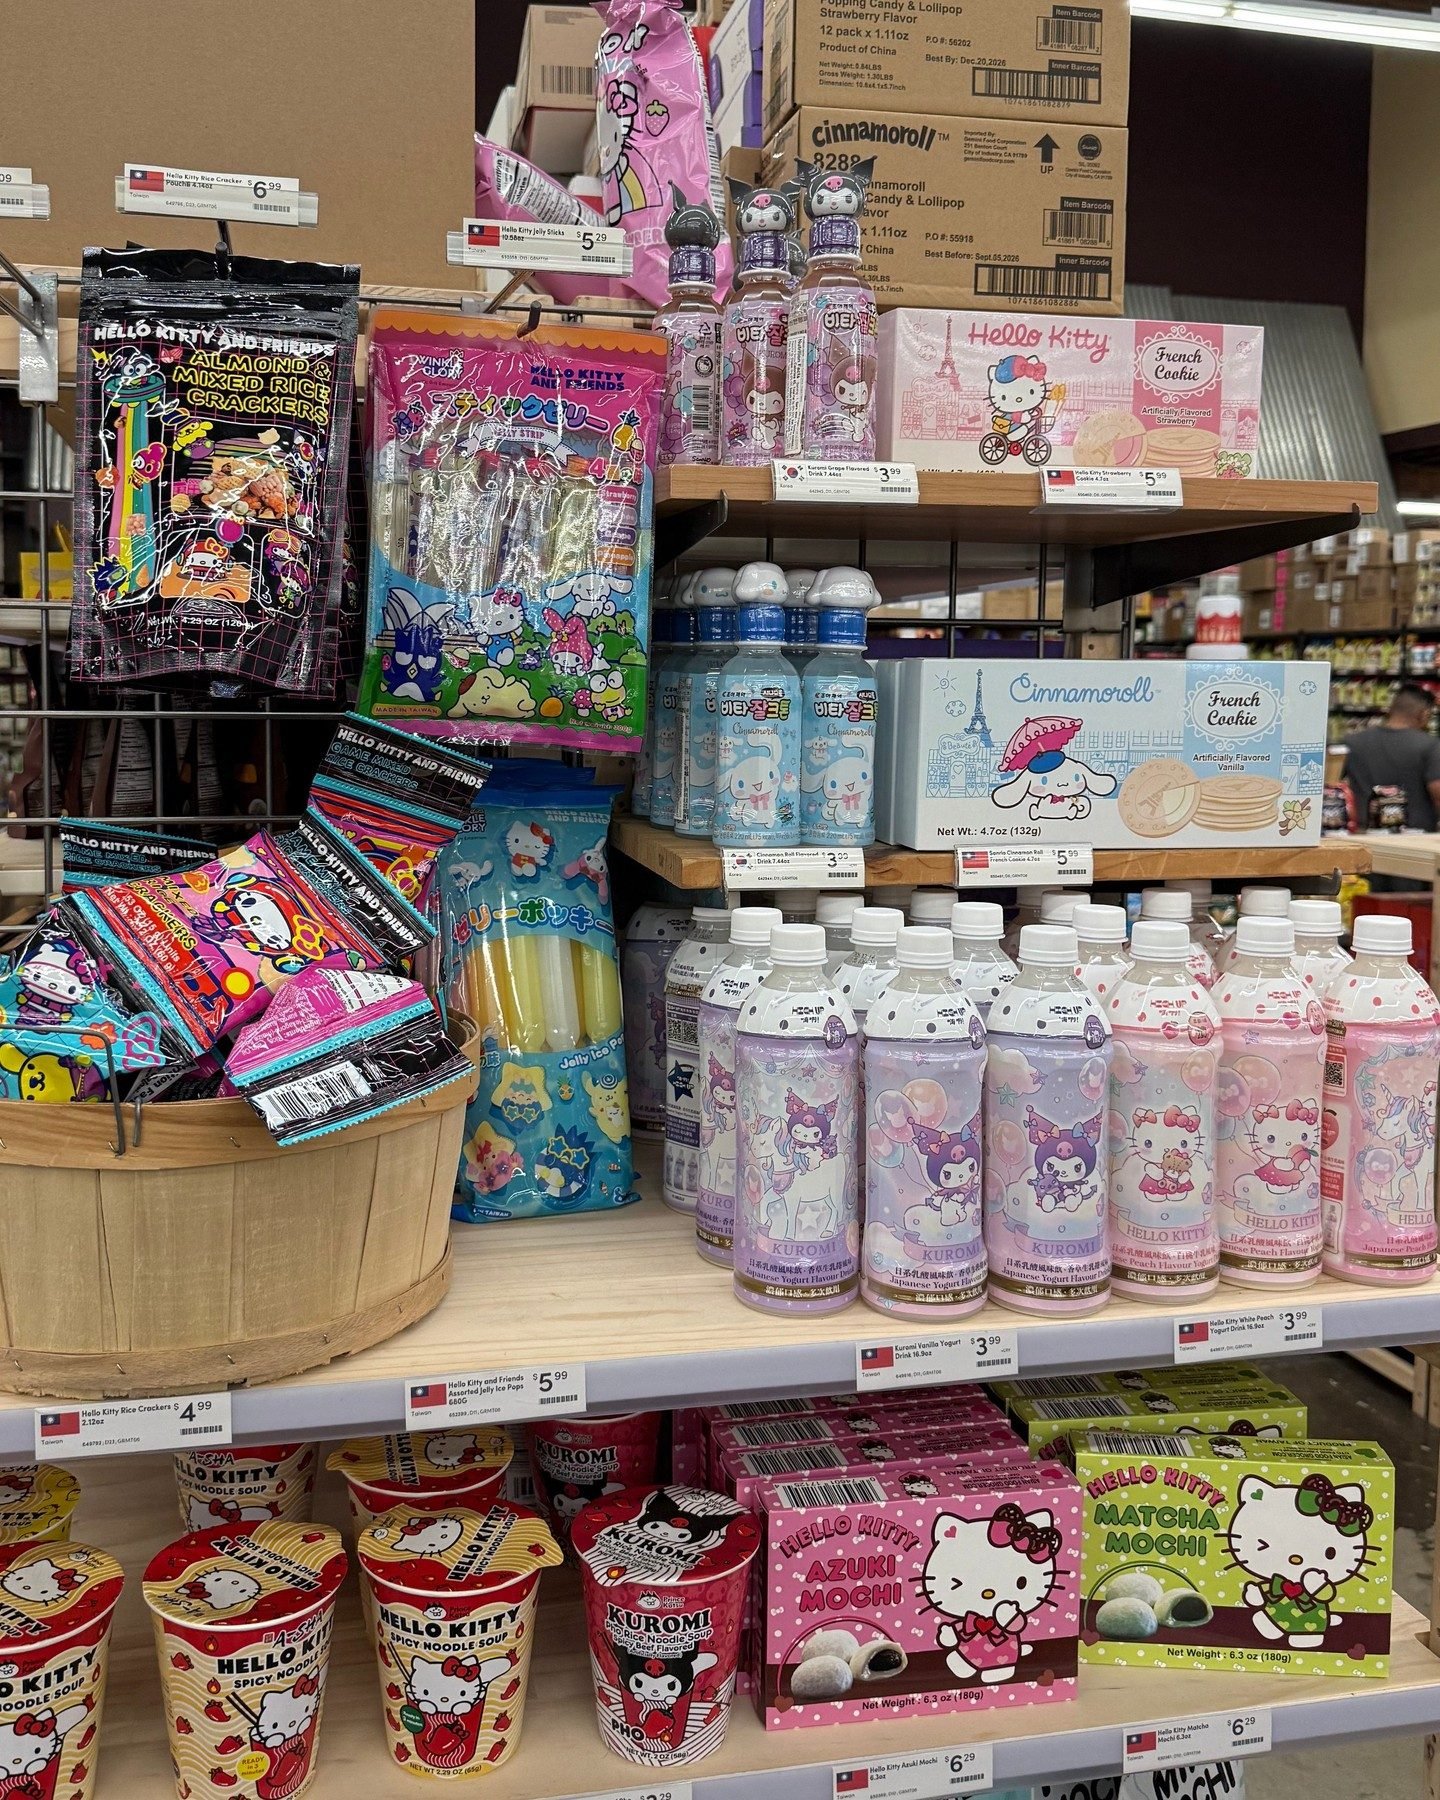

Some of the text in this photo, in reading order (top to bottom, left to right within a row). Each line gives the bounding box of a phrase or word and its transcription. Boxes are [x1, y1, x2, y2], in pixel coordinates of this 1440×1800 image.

[820, 8, 918, 24] Strawberry Flavor
[870, 0, 962, 16] Candy & Lollipop
[1073, 10, 1100, 18] Barcode
[820, 43, 856, 53] Product
[870, 46, 896, 56] China
[812, 119, 936, 151] cinnamoroll
[166, 172, 184, 180] Hello
[185, 173, 200, 182] Kitty
[215, 176, 243, 184] Cracker
[1040, 166, 1054, 174] UP
[866, 193, 964, 210] Candy & Lollipop
[518, 227, 532, 235] Kitty
[533, 228, 546, 236] Jelly
[925, 250, 943, 258] Best
[945, 252, 973, 260] Before:
[1080, 258, 1109, 266] Barcode
[94, 324, 336, 357] HELLO KITTY AND FRIENDS
[968, 322, 1112, 364] Hello Kitty
[1154, 346, 1202, 365] French
[189, 350, 332, 381] ALMOND &
[1154, 364, 1200, 381] Cookie
[578, 368, 625, 381] KITTY
[173, 366, 331, 403] MIXED RICE
[565, 379, 625, 391] FRIENDS
[186, 388, 329, 425] CRACKERS
[1142, 407, 1211, 419] Artificially Flavored
[1156, 416, 1196, 427] Strawberry
[1009, 672, 1155, 704] Cinnamoroll
[1208, 690, 1260, 709] French
[1207, 710, 1258, 727] Cookie
[733, 722, 779, 736] Cinnamoroll
[331, 742, 411, 774] GAME MIXED
[337, 729, 483, 789] HELLO KITTY AND FRIENDS
[1193, 753, 1270, 764] Artificially Flavored
[324, 754, 418, 790] RICE CRACKERS
[1218, 763, 1245, 772] Vanilla
[937, 826, 956, 836] Net
[980, 826, 1008, 836] 4.7oz
[1009, 825, 1042, 837] (132g)
[60, 833, 216, 859] HELLO KITTY AND FRIENDS
[299, 820, 422, 948] HELLO KITTY AND FRIENDS
[560, 1044, 608, 1070] Jelly Ice
[1126, 1225, 1209, 1243] HELLO KITTY
[772, 1242, 836, 1256] KUROMI
[1032, 1241, 1097, 1255] KUROMI
[745, 1267, 839, 1285] Japanese Yogurt Flavour
[1226, 1318, 1238, 1326] Kitty
[1256, 1314, 1274, 1322] Peach
[1210, 1327, 1229, 1335] Yogurt
[895, 1339, 961, 1352] Kuromi Vanilla Yogurt
[449, 1381, 466, 1389] Hello
[467, 1379, 483, 1388] Kitty
[499, 1375, 524, 1384] Friends
[449, 1387, 478, 1397] Assorted
[479, 1385, 494, 1395] Jelly
[508, 1383, 524, 1392] Pops
[82, 1403, 171, 1417] Hello Kitty Rice Crackers
[82, 1418, 104, 1426] 2.12oz
[212, 1464, 279, 1484] KITTY
[1086, 1464, 1228, 1507] HELLO KITTY
[1094, 1503, 1221, 1531] MATCHA
[603, 1527, 704, 1564] KUROMI
[779, 1515, 923, 1559] HELLO KITTY
[1105, 1532, 1207, 1557] MOCHI
[806, 1555, 897, 1584] AZUKI
[799, 1582, 902, 1613] MOCHI
[379, 1605, 521, 1638] HELLO KITTY
[607, 1602, 712, 1634] KUROMI
[605, 1620, 713, 1644] Pho Rice Noodle Soup
[390, 1632, 508, 1652] SPICY NOODLE SOUP
[613, 1634, 693, 1652] Spicy Beef Flavored
[216, 1647, 292, 1675] HELLO
[1167, 1647, 1292, 1664] Net Weight 6.3 oz (180g)
[22, 1646, 98, 1695] KITTY
[611, 1718, 645, 1742] PHO
[1174, 1726, 1186, 1734] Kitty
[1187, 1723, 1209, 1732] Matcha
[1158, 1733, 1191, 1743] Mochi 6.3oz
[887, 1764, 900, 1772] Kitty
[902, 1760, 918, 1768] Azuki
[919, 1757, 938, 1766] Mochi
